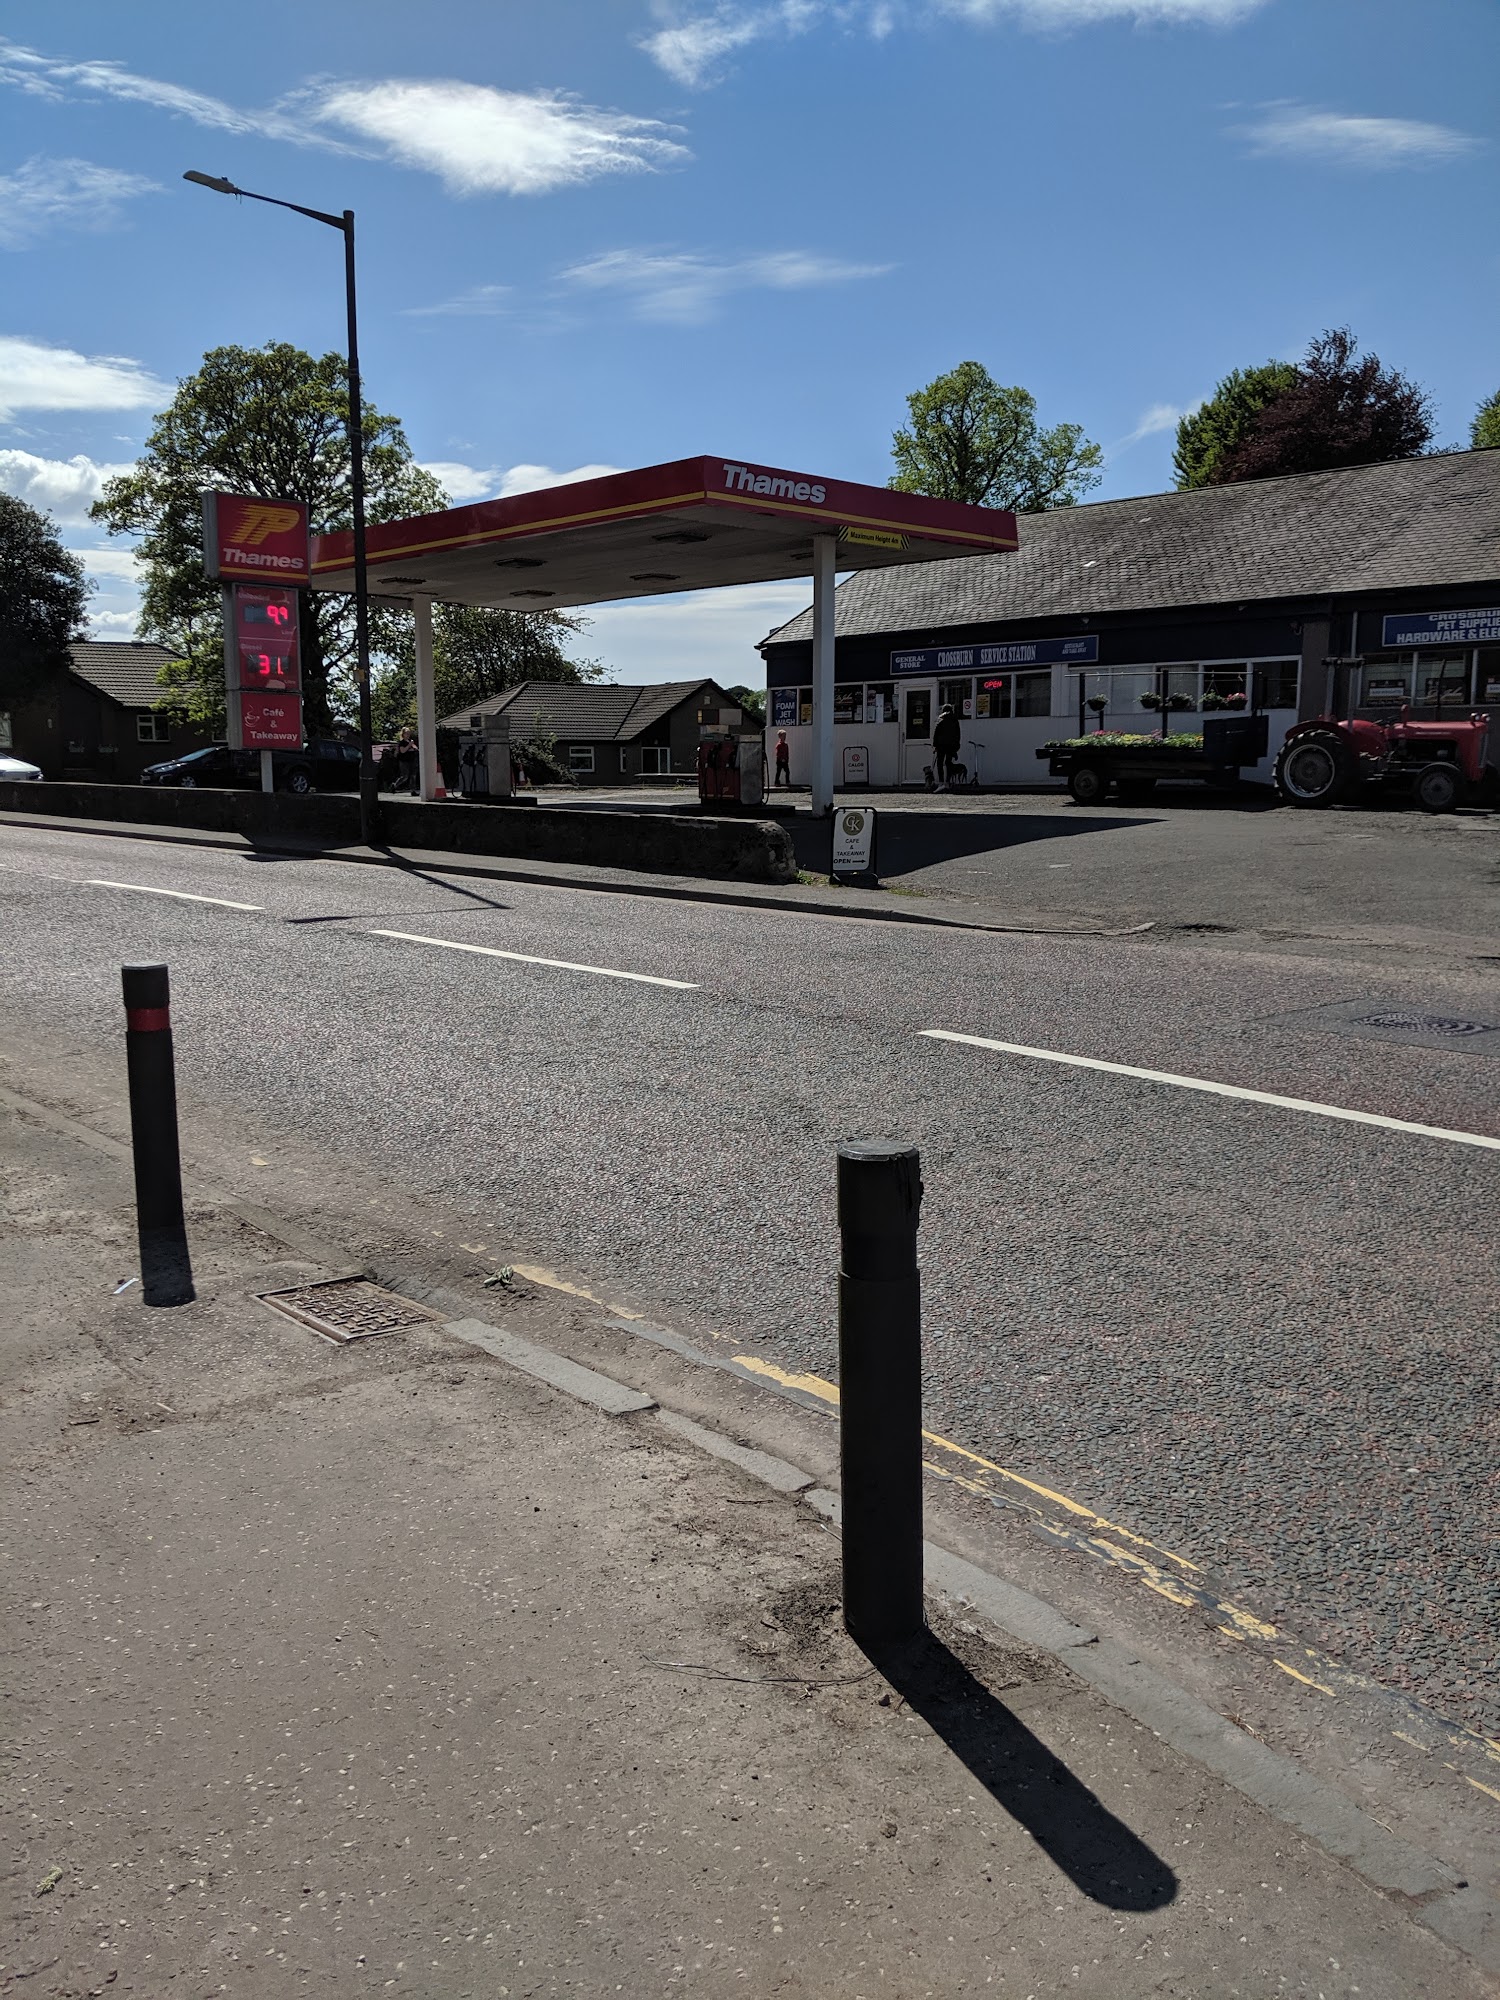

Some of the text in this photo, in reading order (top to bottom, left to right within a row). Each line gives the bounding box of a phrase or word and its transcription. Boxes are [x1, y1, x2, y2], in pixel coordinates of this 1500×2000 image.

[723, 463, 827, 504] Thames
[850, 531, 875, 541] Maximum
[875, 534, 891, 544] Height
[223, 547, 305, 569] Thames
[1437, 620, 1457, 631] PET
[1396, 628, 1466, 644] HARDWARE
[1467, 628, 1479, 639] &
[895, 655, 926, 664] GENERAL
[937, 644, 1037, 668] CROSSBURN SERVICE STATION
[899, 661, 921, 669] STORE
[983, 680, 1003, 690] OPEN
[775, 701, 796, 711] FOAM
[262, 707, 285, 717] Café
[779, 710, 792, 719] JET
[270, 719, 278, 729] &
[775, 718, 796, 726] WASH
[249, 730, 299, 742] Takeaway
